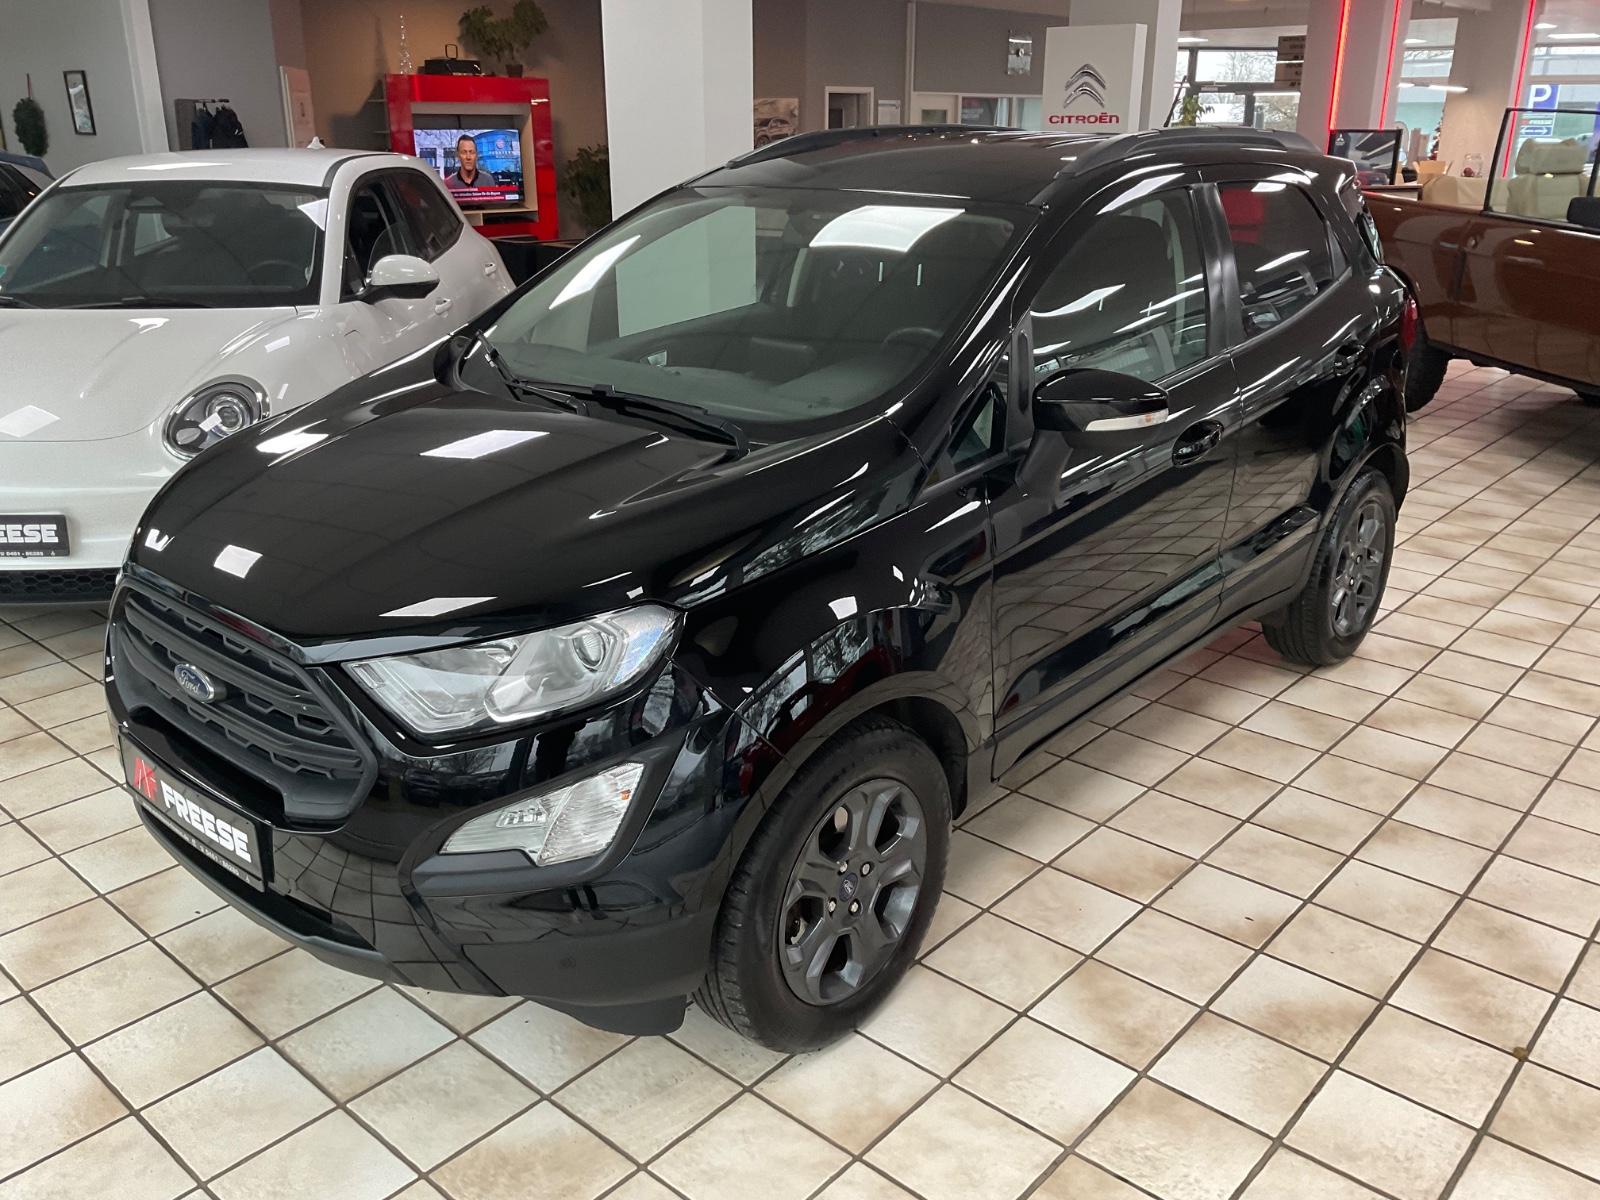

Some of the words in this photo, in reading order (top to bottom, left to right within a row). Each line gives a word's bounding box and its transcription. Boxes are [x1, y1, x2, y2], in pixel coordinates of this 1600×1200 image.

[1528, 85, 1552, 109] P
[178, 669, 201, 694] Ford
[160, 780, 252, 863] FREESE
